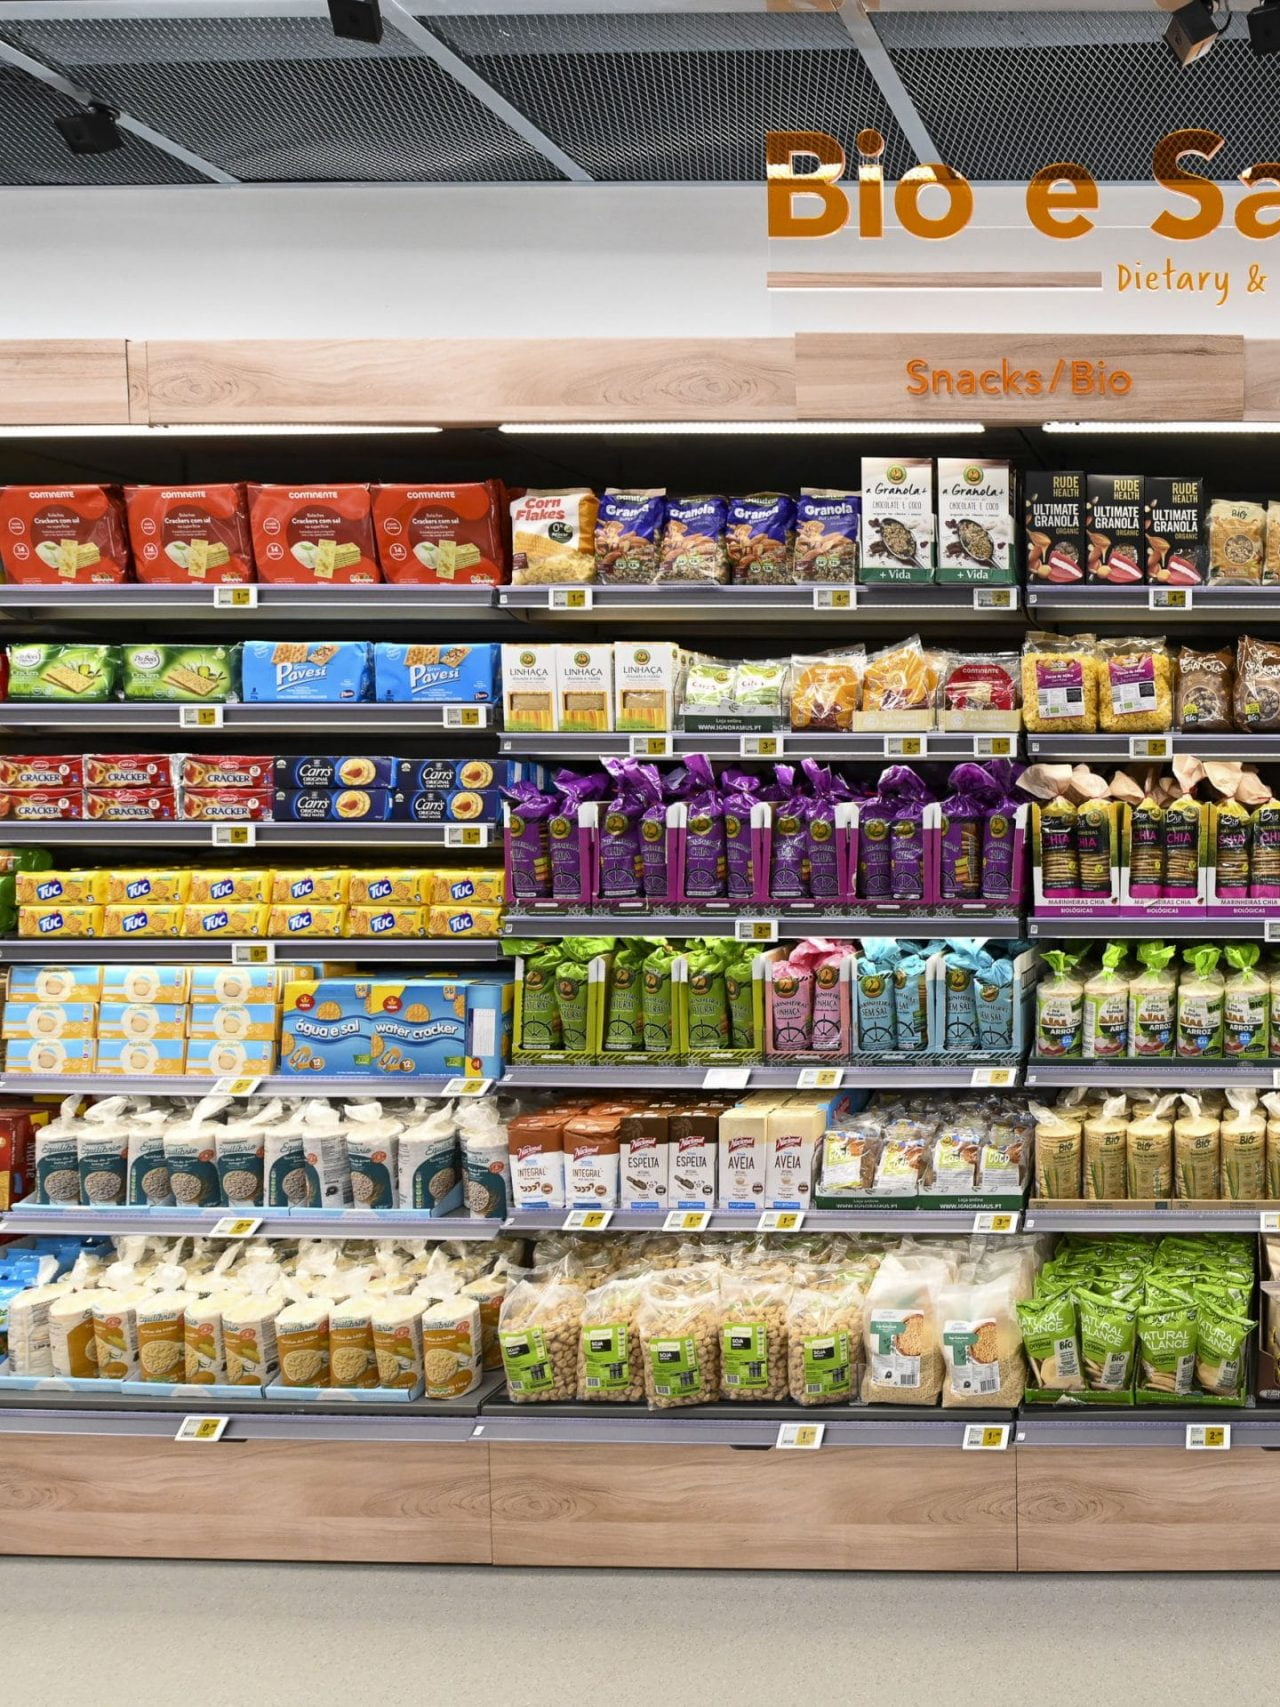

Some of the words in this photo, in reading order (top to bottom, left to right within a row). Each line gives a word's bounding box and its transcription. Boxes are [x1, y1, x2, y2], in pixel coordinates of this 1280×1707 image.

[765, 128, 975, 241] Bio
[1025, 163, 1099, 241] e
[1117, 257, 1229, 306] Dietary
[1247, 263, 1266, 293] &
[905, 357, 1133, 396] Snacks/Bio
[1053, 476, 1079, 488] RUDE
[1114, 480, 1139, 491] RUDE
[1053, 488, 1079, 497] HEALTH
[1172, 483, 1197, 494] RUDE
[1114, 491, 1139, 500] HEALTH
[1172, 494, 1197, 503] HEALTH
[525, 498, 561, 509] Corn
[515, 509, 565, 521] Flakes
[670, 504, 715, 519] Granola
[805, 504, 853, 515] Granola
[1033, 504, 1079, 516] ULTIMATE
[1094, 506, 1139, 517] ULTIMATE
[1152, 509, 1197, 521] ULTIMATE
[1034, 515, 1079, 527] GRANOLA
[1095, 517, 1139, 529] GRANOLA
[1154, 520, 1197, 532] GRANOLA
[889, 569, 910, 579] Vida
[967, 569, 988, 579] Vida
[276, 663, 327, 686] Pavesi
[410, 664, 459, 686] Pavesi
[510, 668, 548, 677] LINHAÇA
[564, 668, 602, 677] LINHAÇA
[623, 666, 662, 675] LINHAÇA
[299, 765, 333, 776] Carr's
[422, 768, 453, 780] Carr's
[20, 774, 59, 782] CRACKER
[108, 773, 147, 781] CRACKER
[207, 774, 249, 782] CRACKER
[297, 798, 329, 809] Carr's
[415, 799, 445, 810] Carr's
[296, 1019, 327, 1037] água
[330, 1027, 338, 1036] e
[340, 1020, 360, 1034] sal
[376, 1023, 410, 1036] water
[413, 1024, 458, 1039] cracker
[628, 1158, 659, 1168] ESPELTA
[676, 1156, 706, 1167] ESPELTA
[728, 1158, 754, 1170] AVEIA
[775, 1155, 801, 1168] AVEIA
